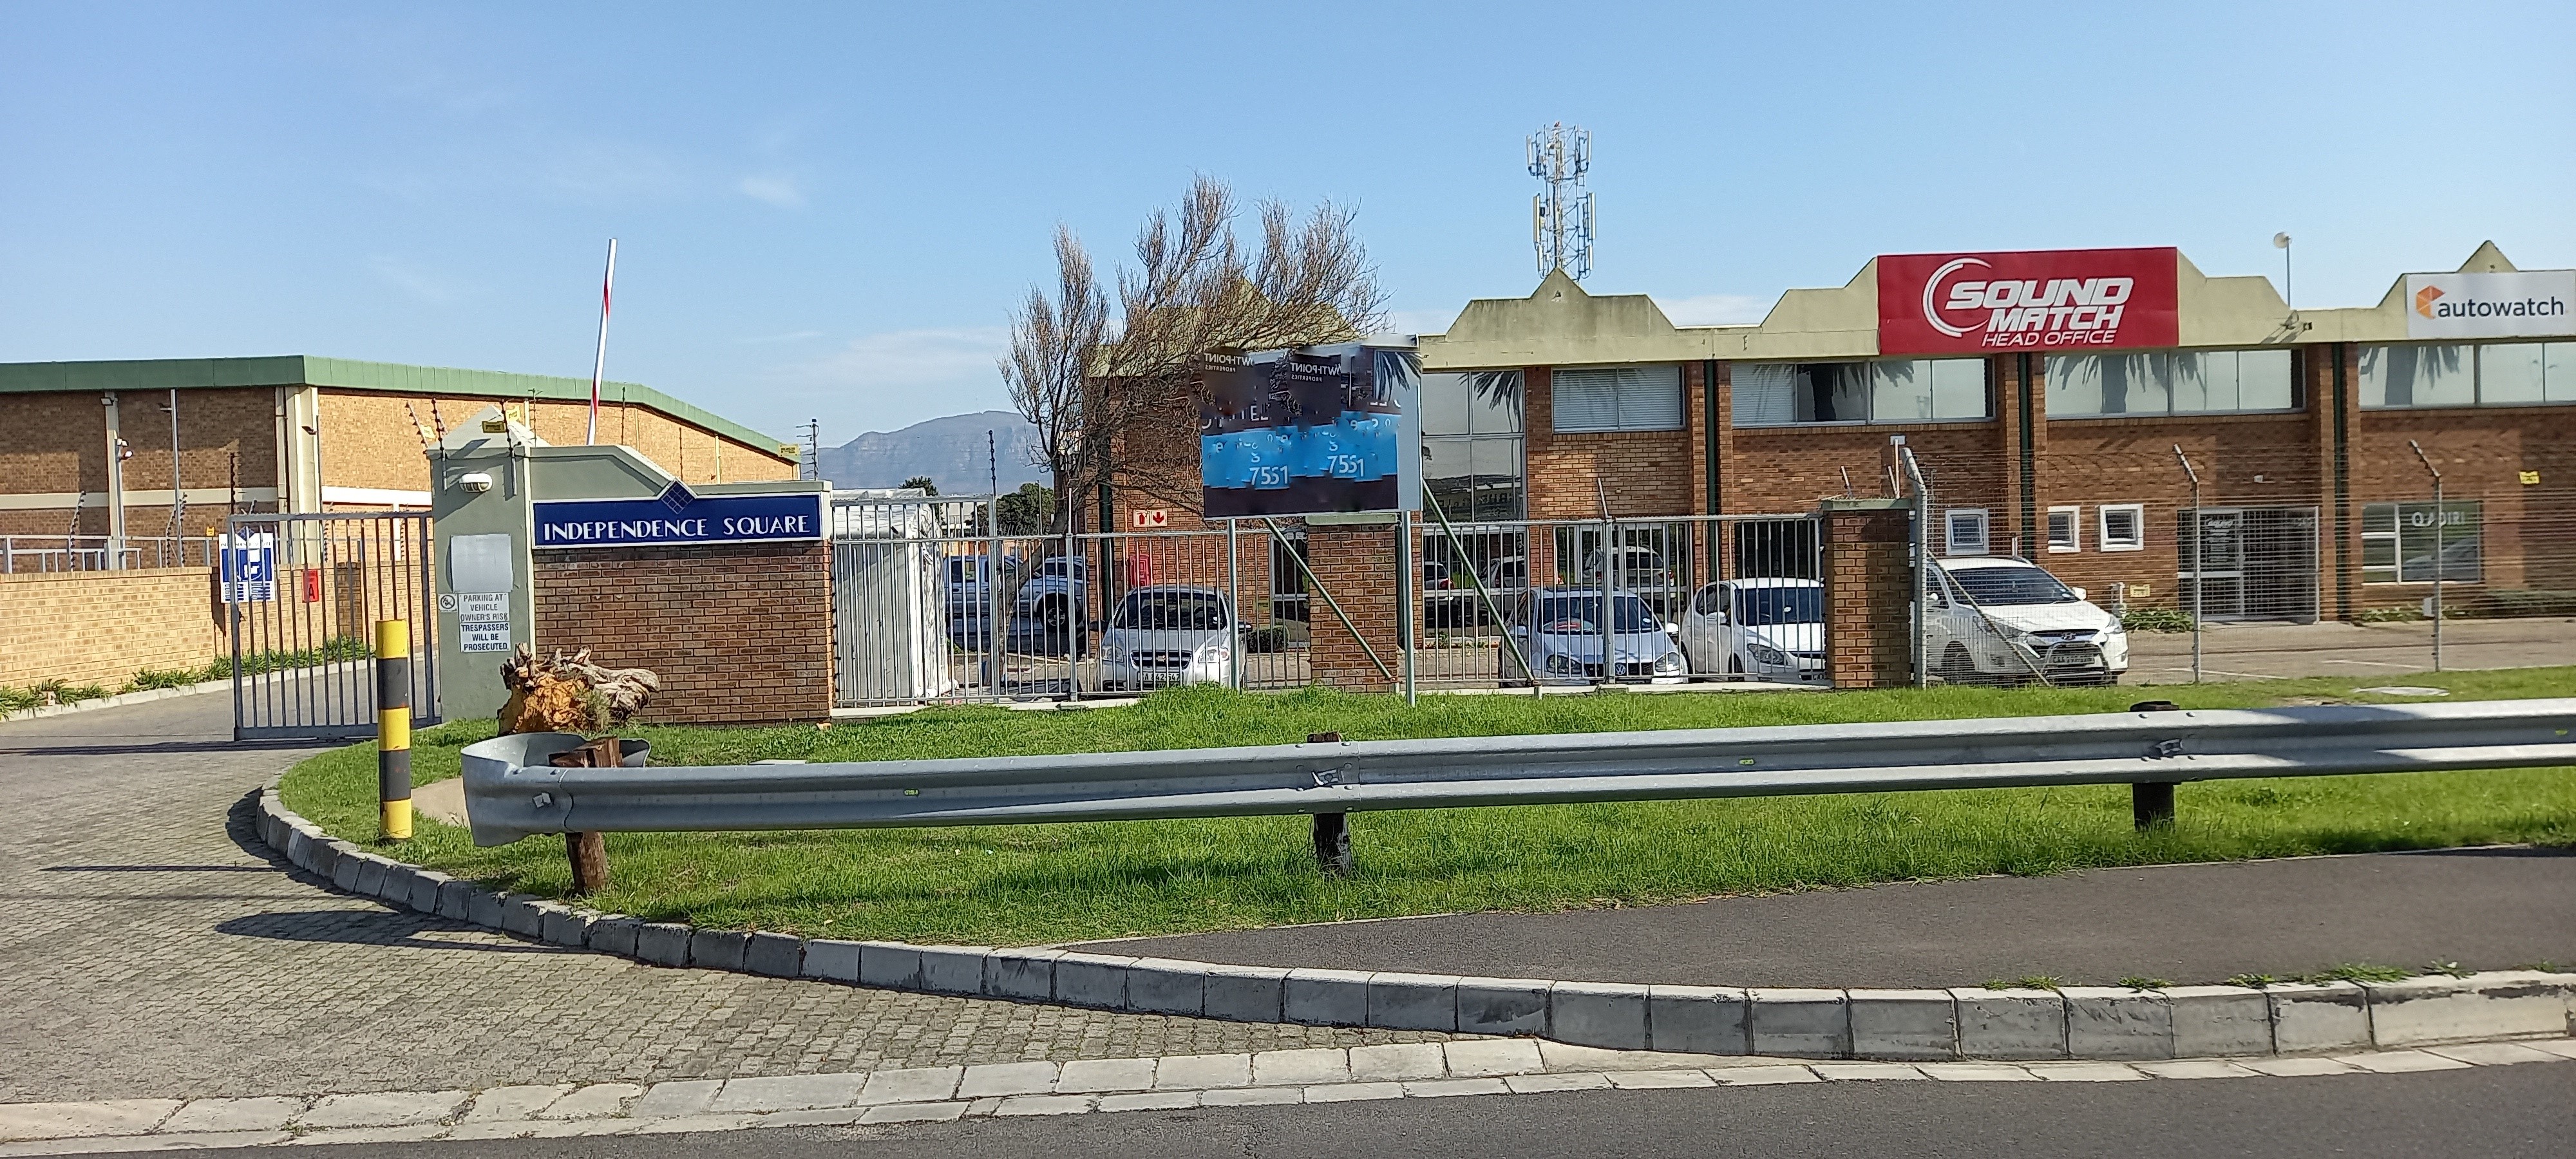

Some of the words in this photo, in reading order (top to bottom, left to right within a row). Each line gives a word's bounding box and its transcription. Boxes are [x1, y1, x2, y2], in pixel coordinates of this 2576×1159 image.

[1945, 277, 2134, 310] SOUND
[2438, 296, 2564, 317] autowatch
[1985, 305, 2125, 332] MATCH
[1982, 332, 2039, 347] HEAD
[2043, 330, 2117, 345] OFFICE
[544, 518, 708, 541] INDEPENDENCE
[723, 514, 811, 536] SQUARE
[463, 594, 493, 602] PARKING
[470, 603, 498, 612] VEHICLE
[492, 612, 509, 621] RISK
[461, 623, 509, 632] TRESPASSERS
[472, 633, 489, 641] WILL
